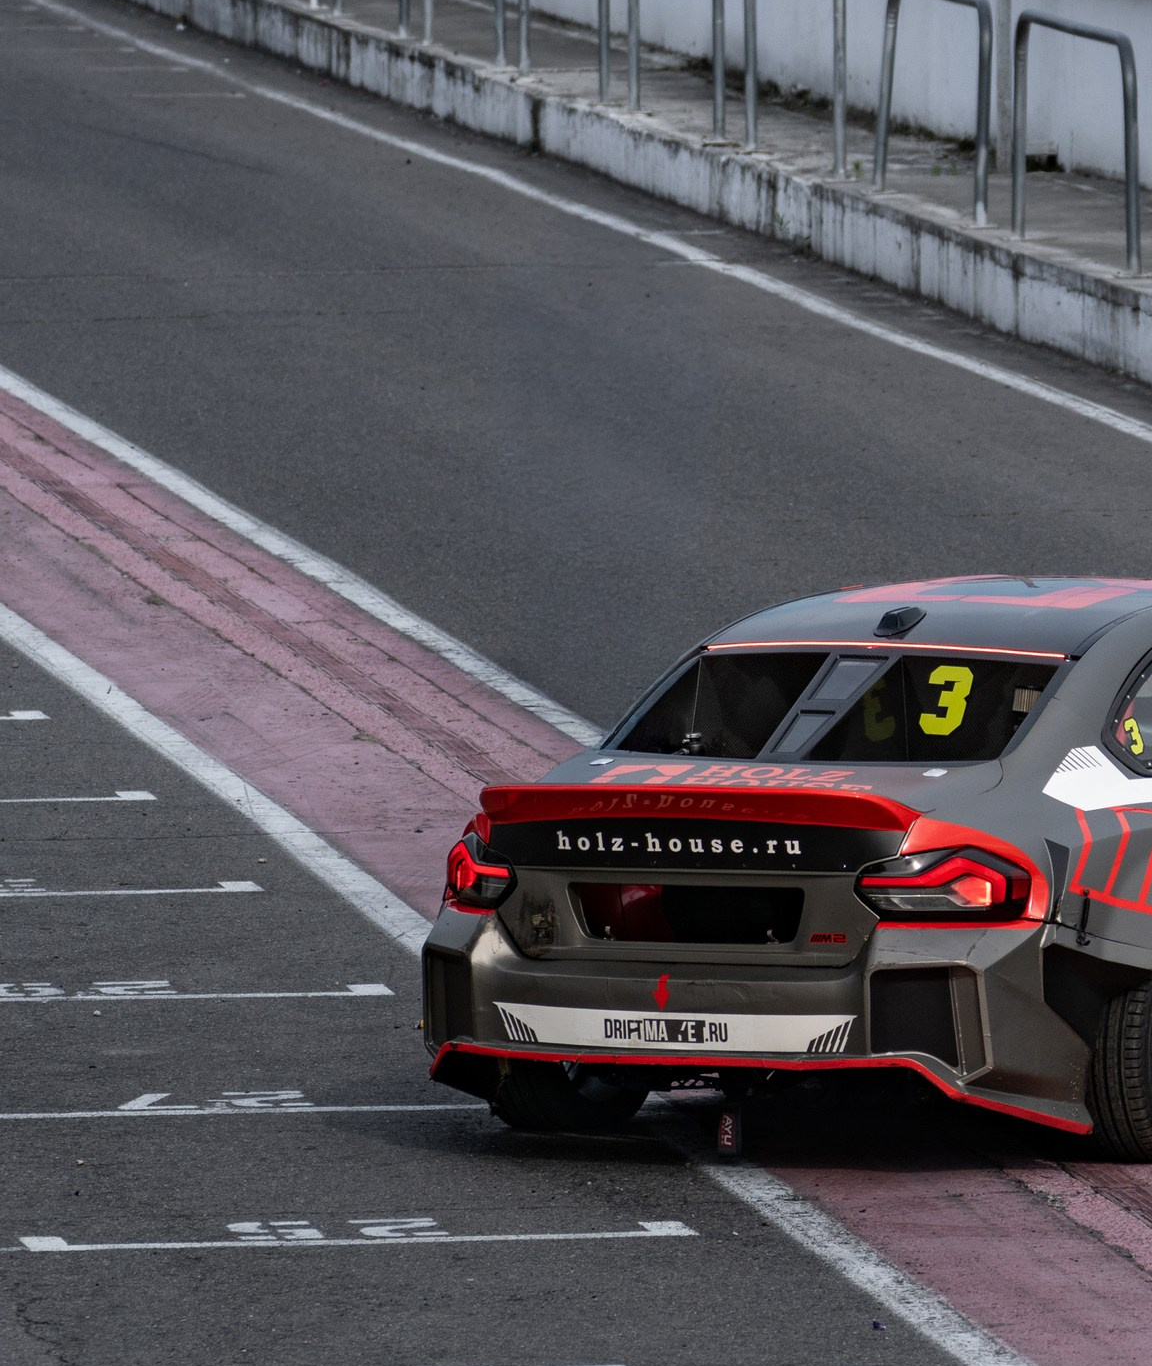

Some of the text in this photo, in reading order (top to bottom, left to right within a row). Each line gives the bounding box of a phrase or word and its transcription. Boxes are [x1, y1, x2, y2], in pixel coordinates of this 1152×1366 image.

[919, 665, 973, 736] 3
[1123, 717, 1144, 755] 3
[693, 765, 856, 782] HOLZ
[557, 831, 802, 855] holz-house.ru
[604, 1019, 728, 1044] DRIFTMAE.RU
[723, 1115, 733, 1146] AYU
